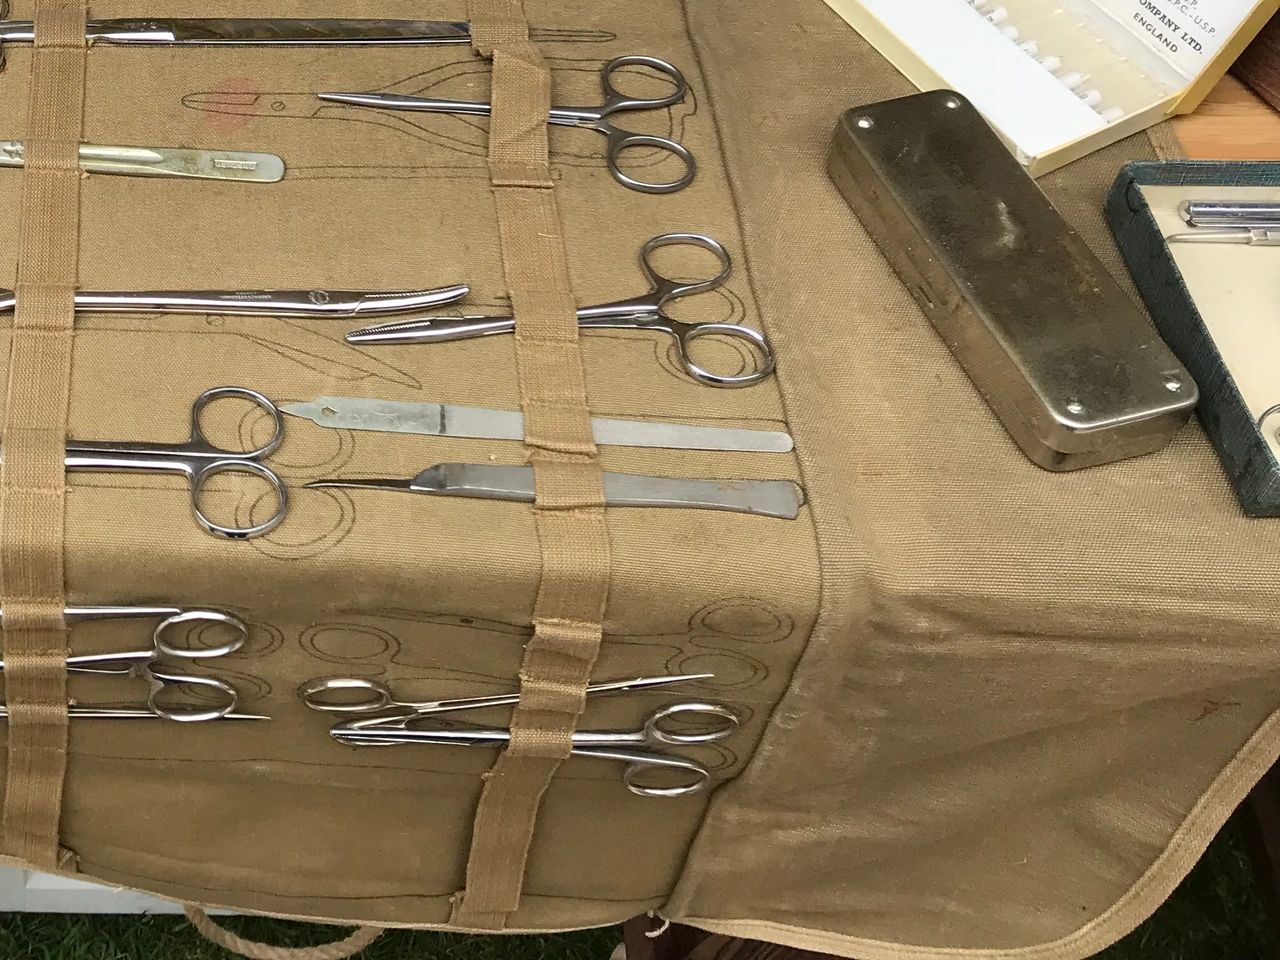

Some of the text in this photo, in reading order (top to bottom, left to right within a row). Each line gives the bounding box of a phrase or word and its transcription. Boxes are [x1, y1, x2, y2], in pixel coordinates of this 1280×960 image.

[1132, 11, 1179, 54] ENGLAND
[1193, 15, 1217, 38] U.S.P.
[1180, 31, 1204, 55] LTD.
